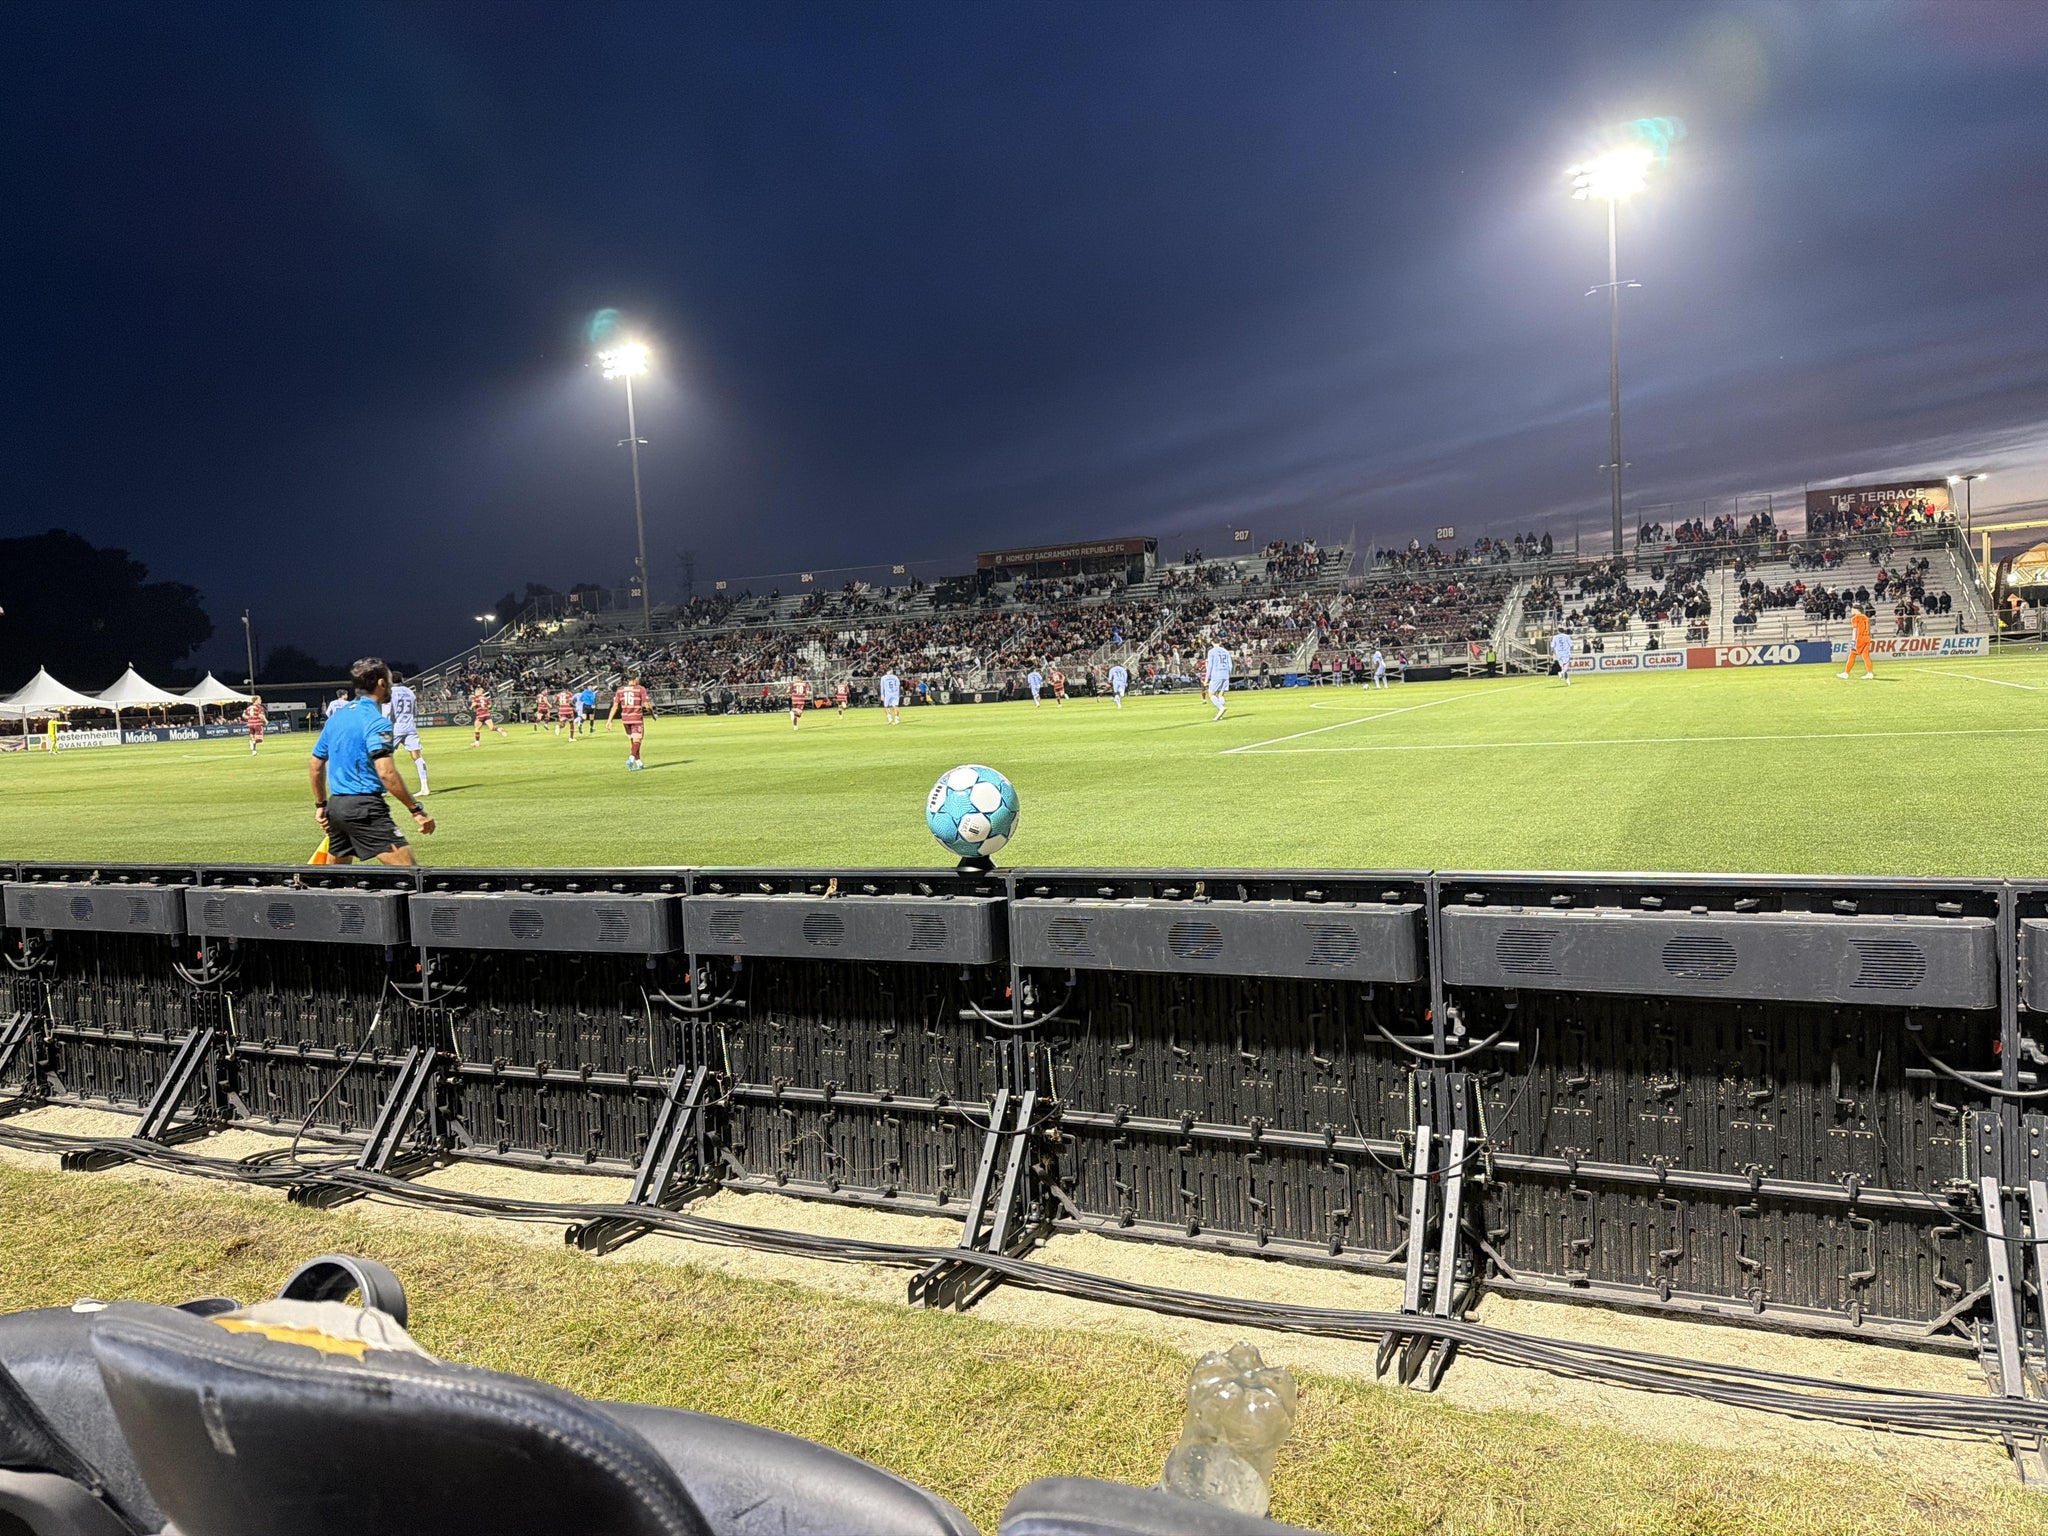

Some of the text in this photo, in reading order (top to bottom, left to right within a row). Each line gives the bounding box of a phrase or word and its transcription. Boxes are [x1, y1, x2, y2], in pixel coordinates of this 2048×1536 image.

[1829, 488, 1925, 506] THE TERRACE
[1234, 531, 1249, 541] 207
[1437, 528, 1454, 539] 208
[1006, 554, 1024, 562] HOME
[1034, 549, 1080, 560] SACRAMENTO
[1081, 545, 1115, 555] REPUBLIC
[1115, 544, 1125, 552] FC
[1869, 640, 1898, 653] ORK
[1900, 638, 1942, 652] ZONE
[1943, 637, 1983, 649] ALERT
[1715, 644, 1801, 667] FOX40
[1569, 660, 1590, 668] LARK
[624, 691, 634, 706] 16
[125, 731, 158, 744] Modelo
[169, 728, 199, 741] Modelo
[58, 741, 103, 749] DVANTAGE
